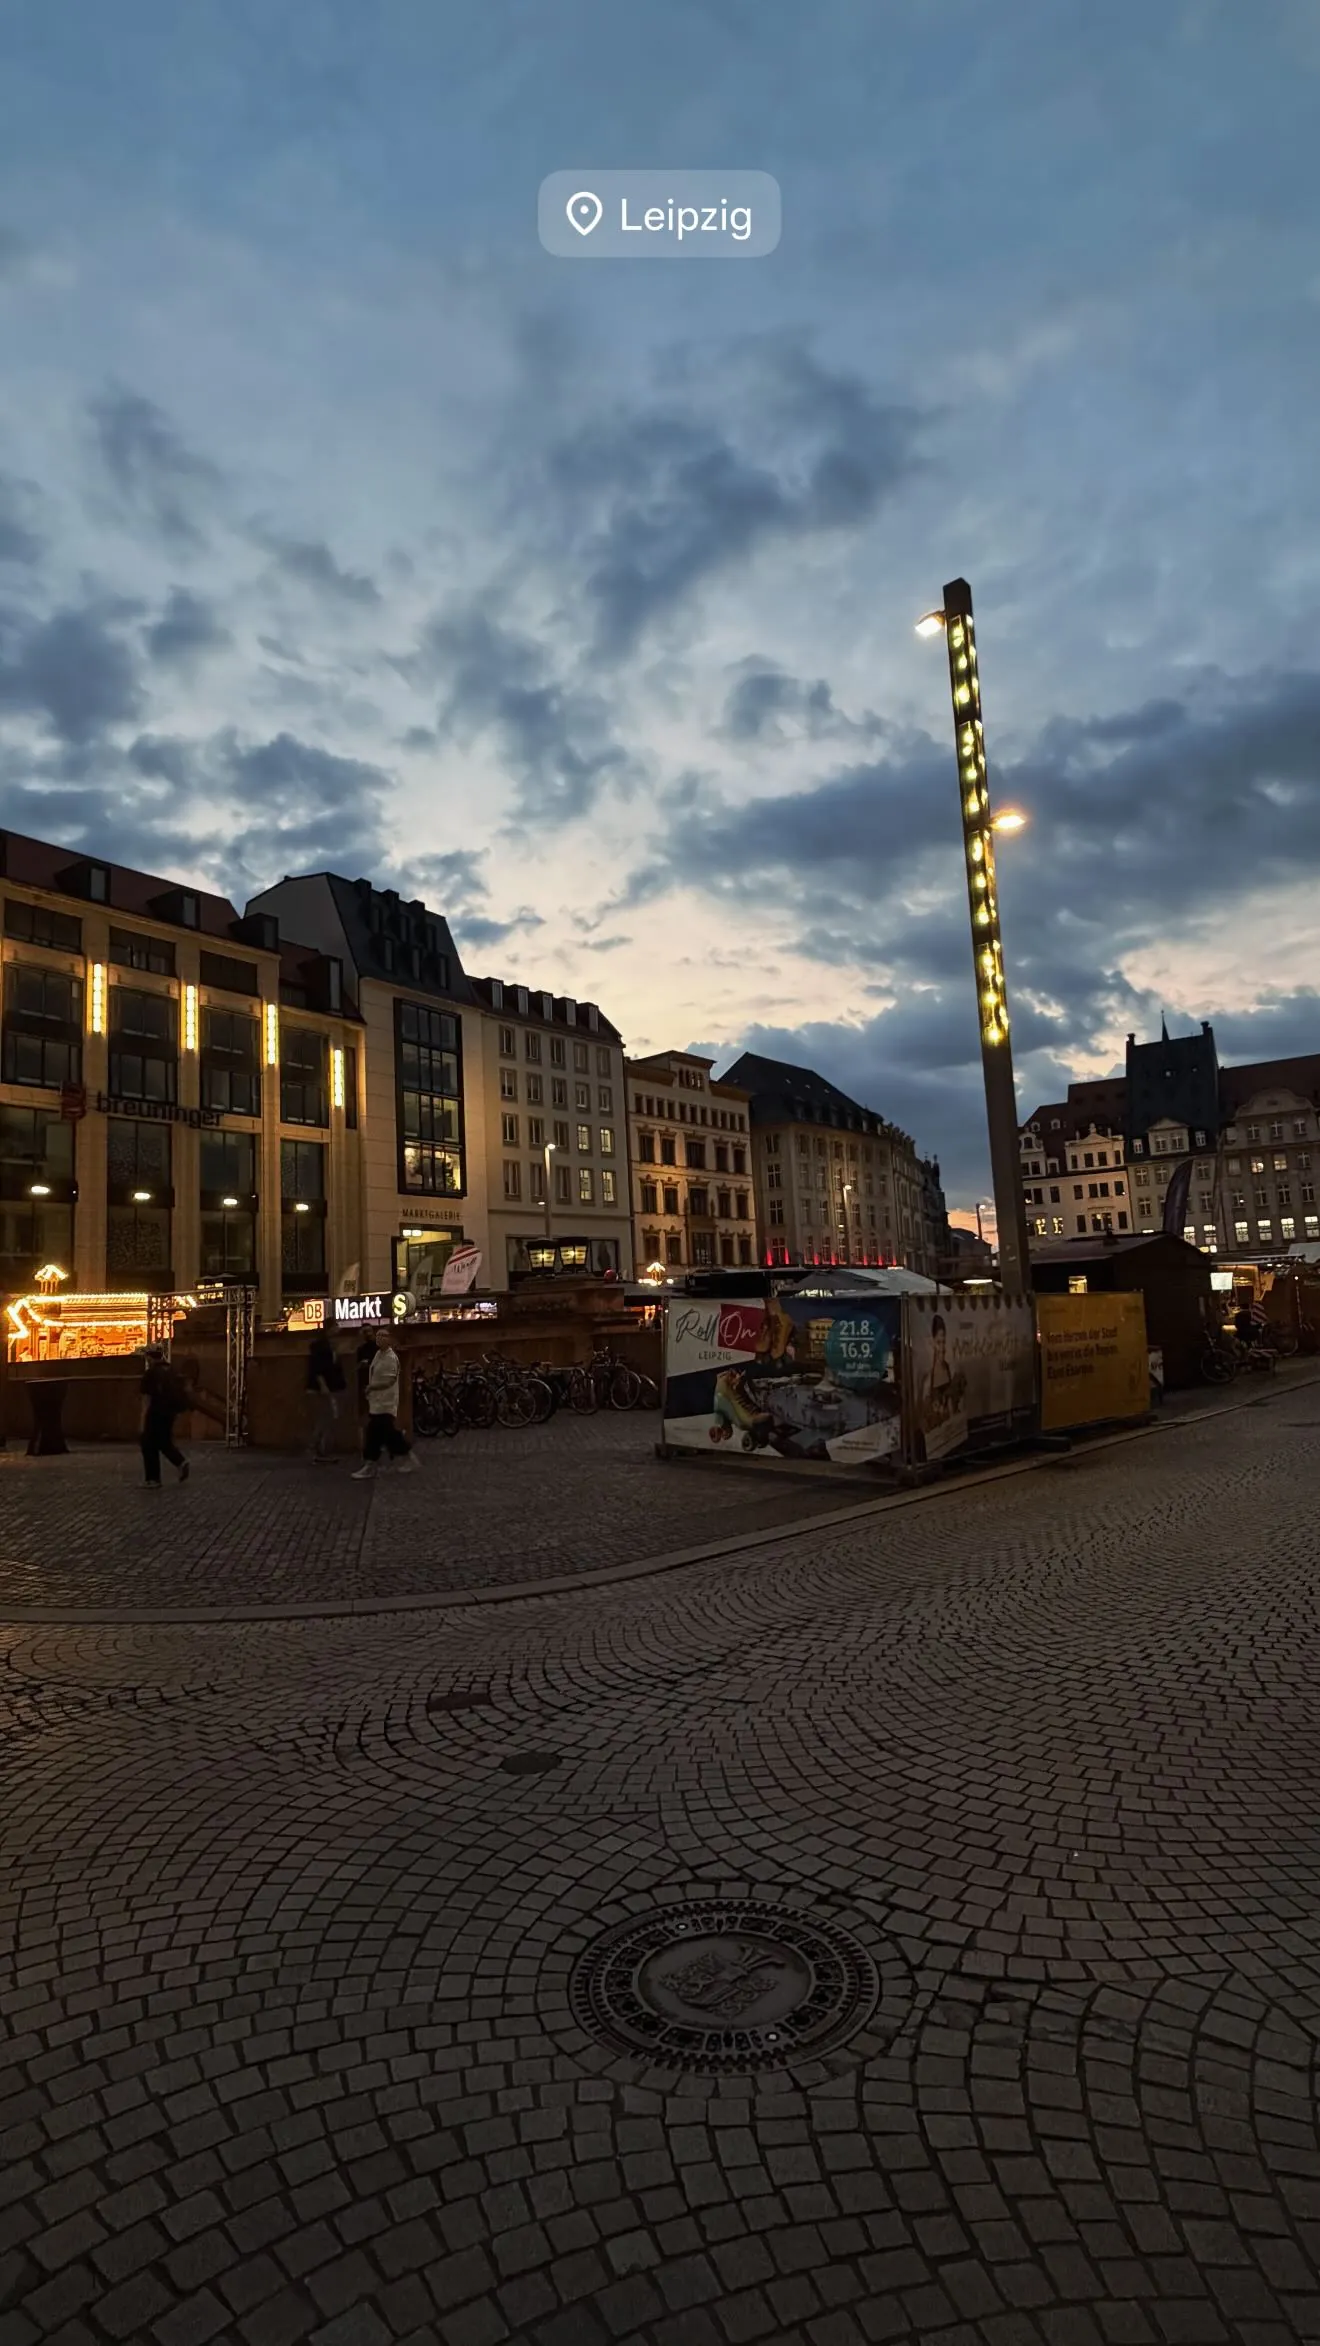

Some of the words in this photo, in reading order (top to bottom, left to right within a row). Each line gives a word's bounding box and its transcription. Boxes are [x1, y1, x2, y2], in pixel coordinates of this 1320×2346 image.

[96, 1090, 224, 1129] breuninger
[402, 1208, 462, 1221] MARKTGALERIE
[306, 1303, 322, 1319] DB
[334, 1295, 382, 1320] Markt
[393, 1293, 407, 1316] S
[675, 1307, 721, 1346] Roll
[720, 1310, 757, 1346] On
[839, 1319, 874, 1336] 21.8.
[698, 1351, 732, 1361] LEIPZIG
[839, 1342, 873, 1358] 16.9.
